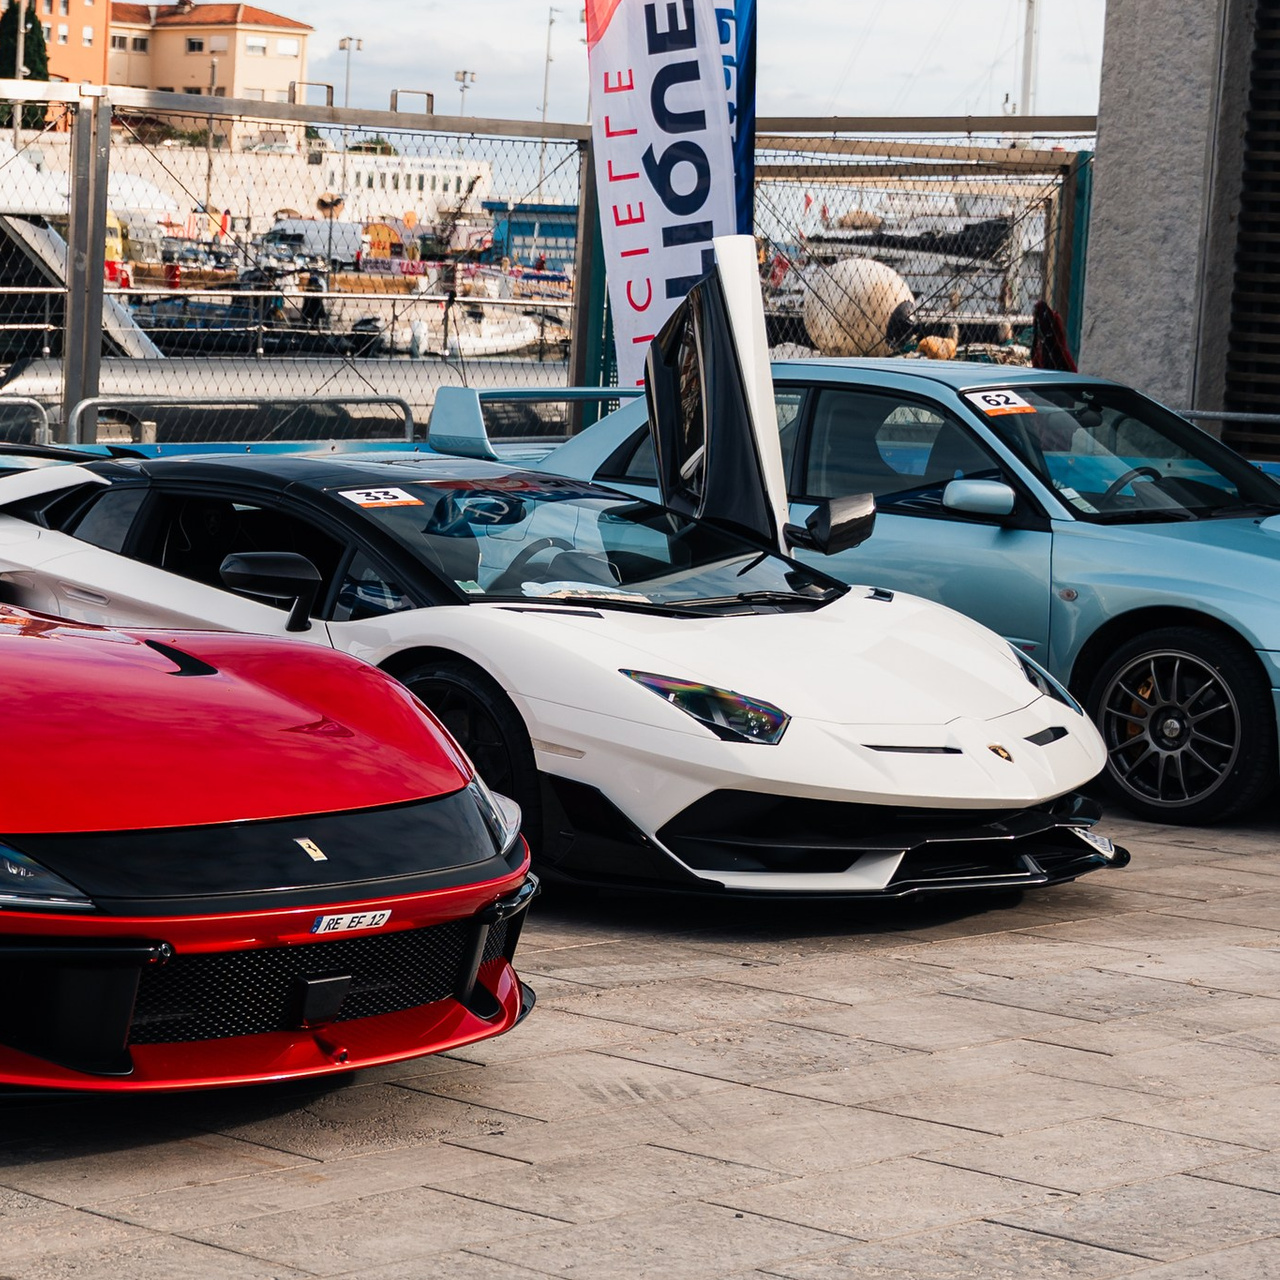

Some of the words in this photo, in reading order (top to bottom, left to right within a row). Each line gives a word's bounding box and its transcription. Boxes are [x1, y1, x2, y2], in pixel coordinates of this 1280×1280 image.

[981, 394, 1017, 407] 62
[355, 491, 399, 501] 33
[323, 917, 343, 932] RE
[347, 915, 367, 929] EF
[366, 913, 385, 927] 12
